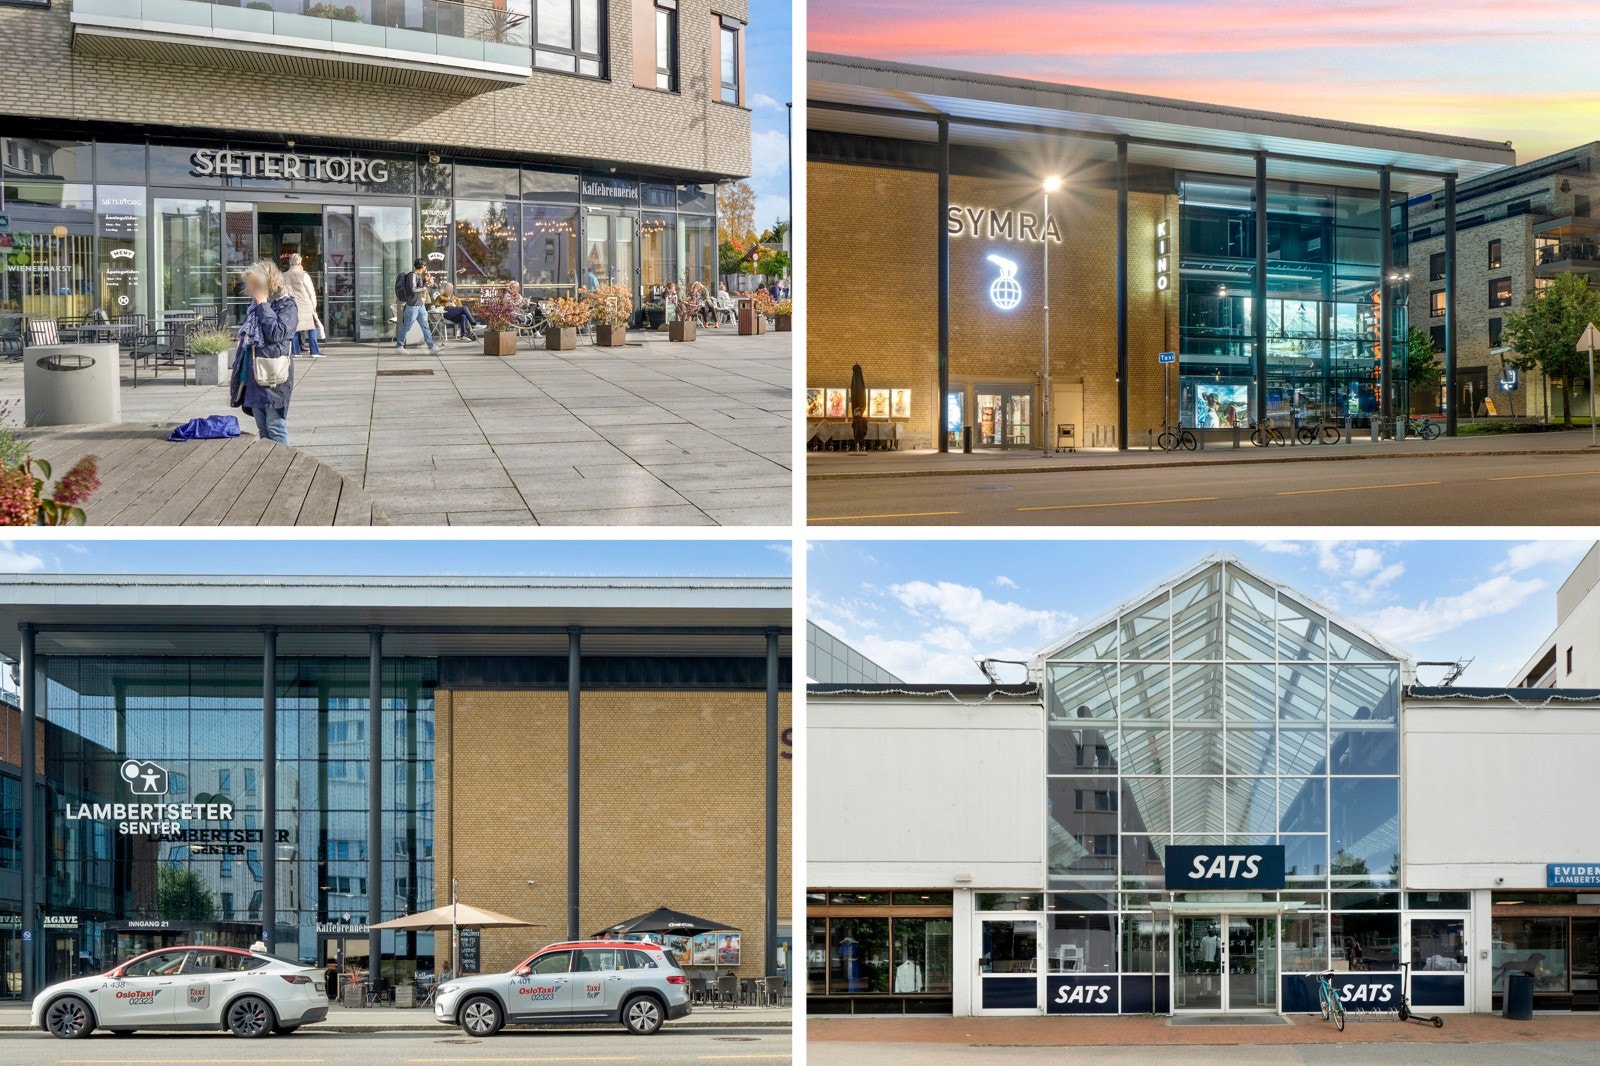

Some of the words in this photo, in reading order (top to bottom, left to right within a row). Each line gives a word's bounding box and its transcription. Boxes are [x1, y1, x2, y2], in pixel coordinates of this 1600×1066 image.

[582, 181, 639, 199] Kaffebrenneriet
[947, 206, 1062, 242] SYMRA
[1157, 221, 1168, 290] KINO
[66, 803, 233, 820] LAMBERTSETER
[119, 821, 181, 835] SENTER
[1187, 854, 1263, 879] SATS
[43, 915, 78, 924] AGAVE
[128, 920, 160, 928] INNGANG
[189, 987, 206, 996] Taxi
[518, 985, 555, 995] OsloTaxi
[586, 983, 601, 992] Taxi
[1340, 984, 1395, 1002] SATS
[115, 989, 155, 999] OsloTaxi
[531, 993, 555, 1001] 02323
[1054, 985, 1111, 1003] SATS
[128, 998, 154, 1006] 02323
